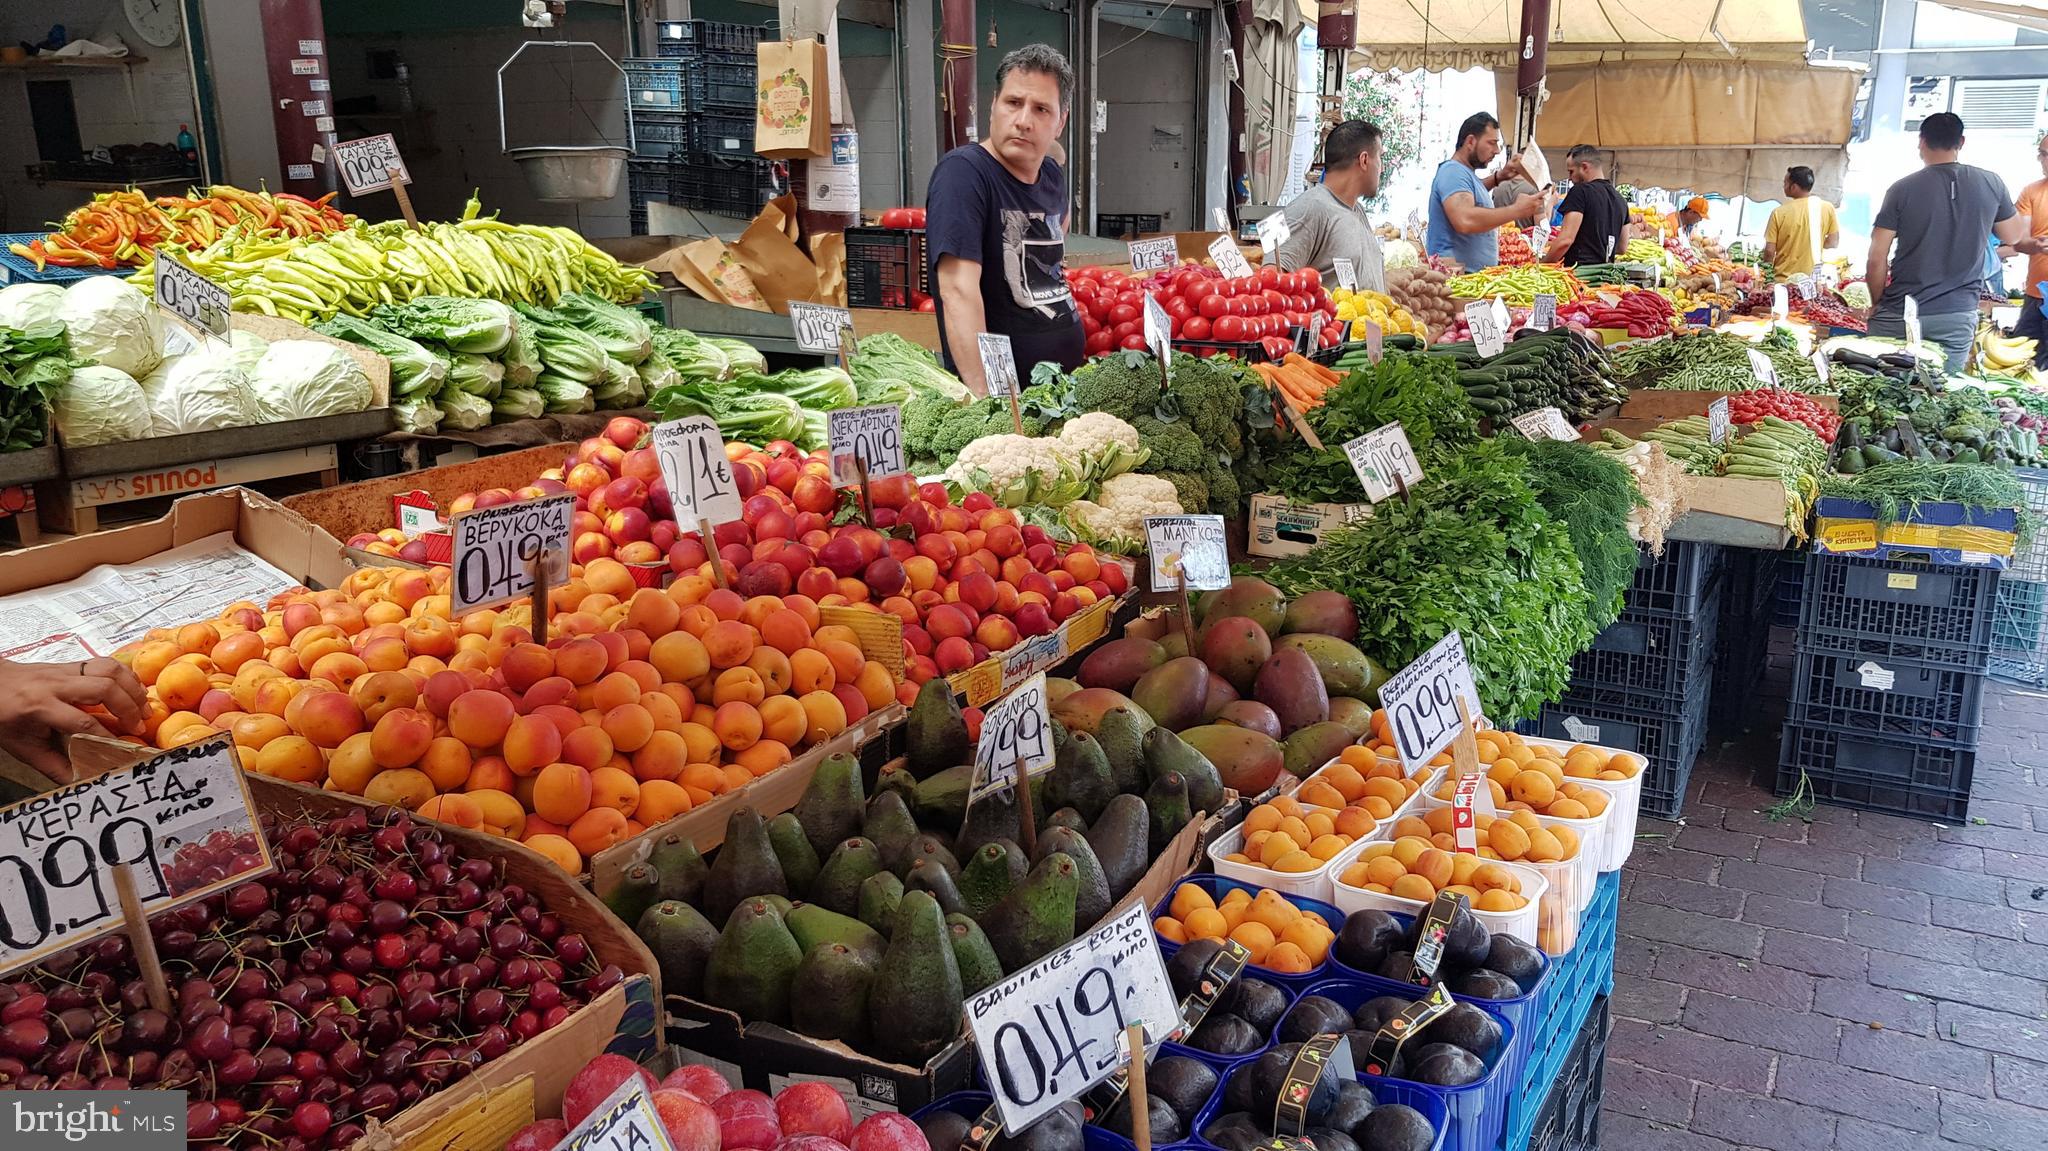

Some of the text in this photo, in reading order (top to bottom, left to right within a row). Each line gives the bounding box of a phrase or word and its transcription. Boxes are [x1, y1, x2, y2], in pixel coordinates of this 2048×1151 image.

[832, 415, 898, 436] ΝΕΚΤΑΡΙΝΙΑ
[132, 466, 216, 496] POULIS
[465, 508, 563, 546] ΒΕΡΥΚΟΚΑ
[17, 770, 186, 848] ΚΕΡΑΣΙΑ
[155, 796, 214, 825] ΚΙΛΟ
[1119, 928, 1143, 943] ΤΟ
